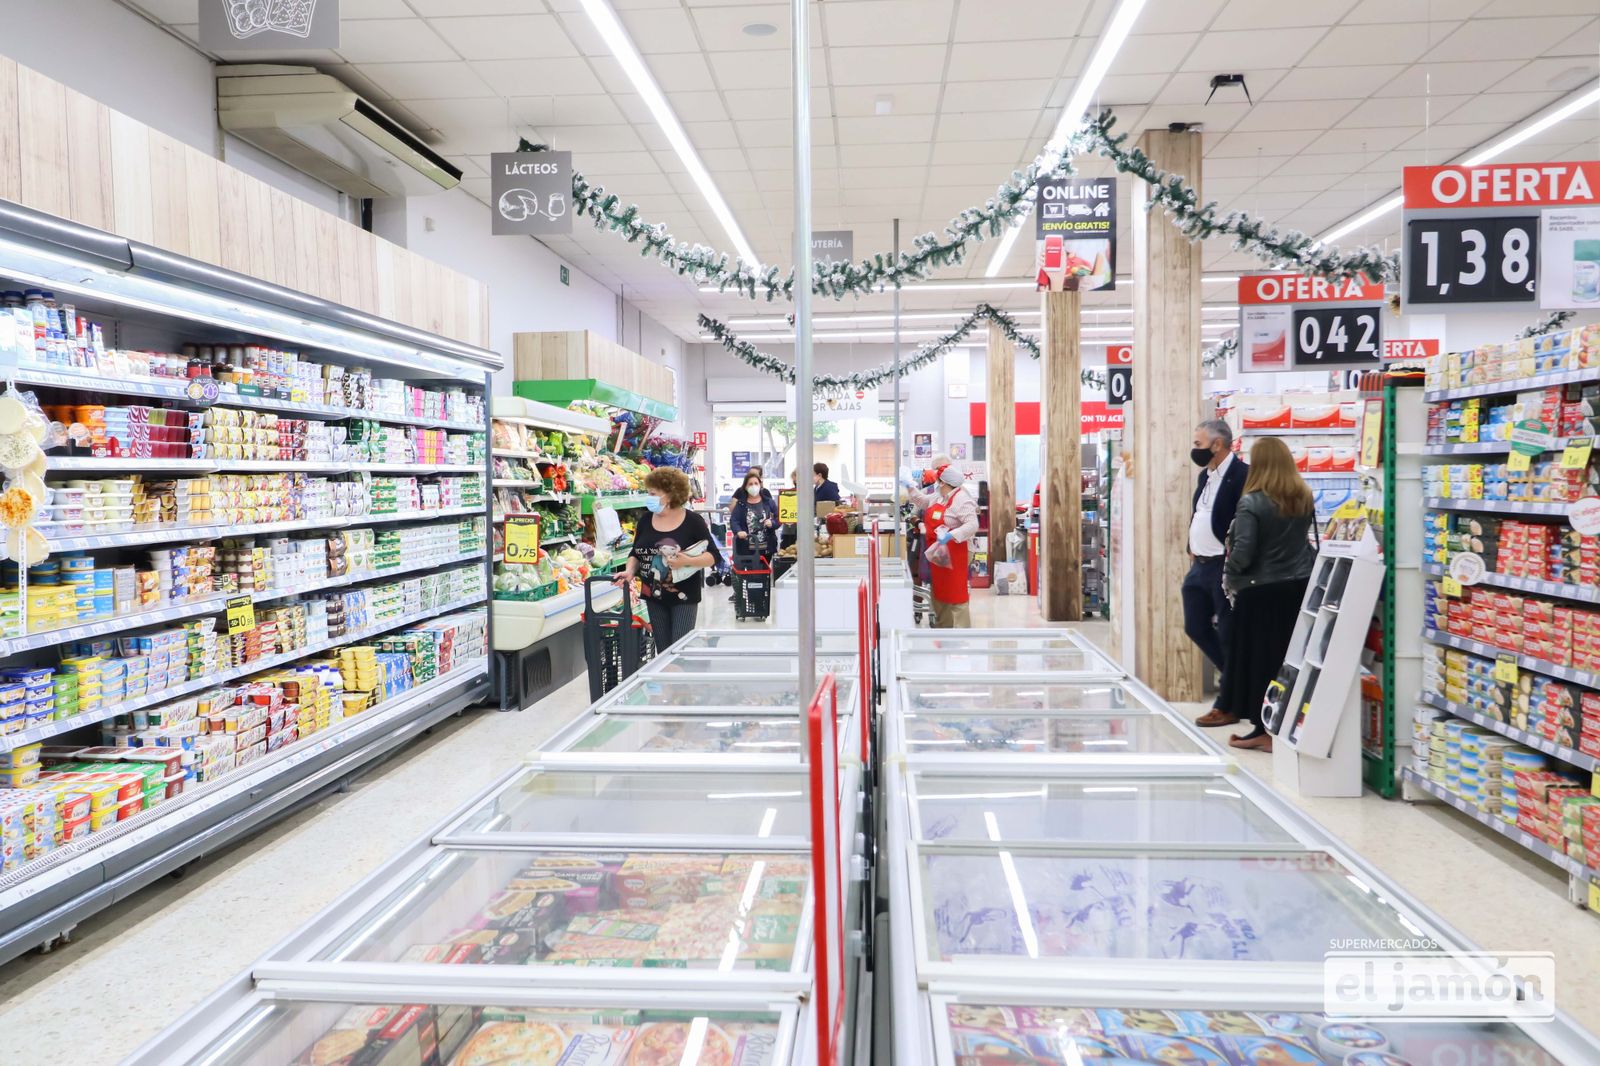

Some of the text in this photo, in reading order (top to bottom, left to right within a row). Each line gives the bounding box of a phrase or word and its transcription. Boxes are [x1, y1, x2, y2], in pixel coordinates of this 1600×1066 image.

[505, 161, 558, 175] LÁCTEOS
[1431, 165, 1594, 204] OFERTA
[1042, 185, 1110, 200] ONLINE
[1074, 221, 1110, 230] GRATIS!
[812, 238, 844, 249] UTERÍA
[1257, 276, 1364, 300] OFERTA
[1384, 341, 1426, 358] ERTA
[812, 402, 826, 411] OR
[831, 402, 862, 411] AJAS
[1081, 414, 1124, 423] ON TU ACE
[506, 542, 536, 559] 0,75
